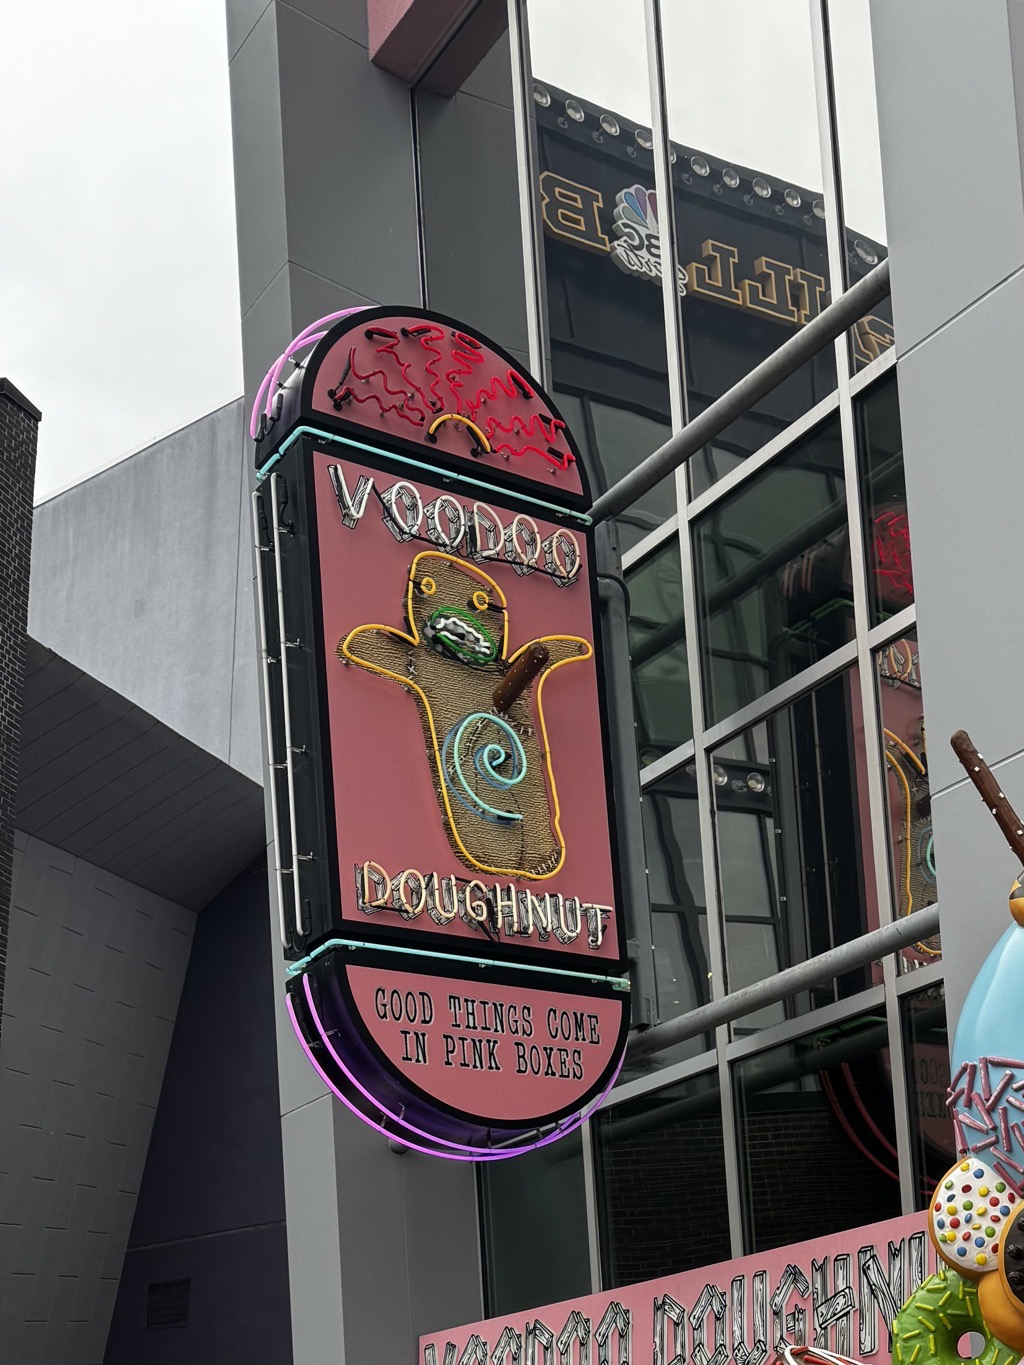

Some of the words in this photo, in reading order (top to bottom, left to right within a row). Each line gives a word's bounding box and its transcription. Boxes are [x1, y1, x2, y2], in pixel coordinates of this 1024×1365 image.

[327, 464, 581, 588] VOODOO
[354, 861, 613, 949] DOUGHNUT
[375, 987, 434, 1025] GOOD
[448, 994, 534, 1038] THINGS
[547, 1007, 601, 1045] COME
[400, 1030, 428, 1064] IN
[442, 1033, 502, 1071] PINK
[514, 1041, 584, 1081] BOXES
